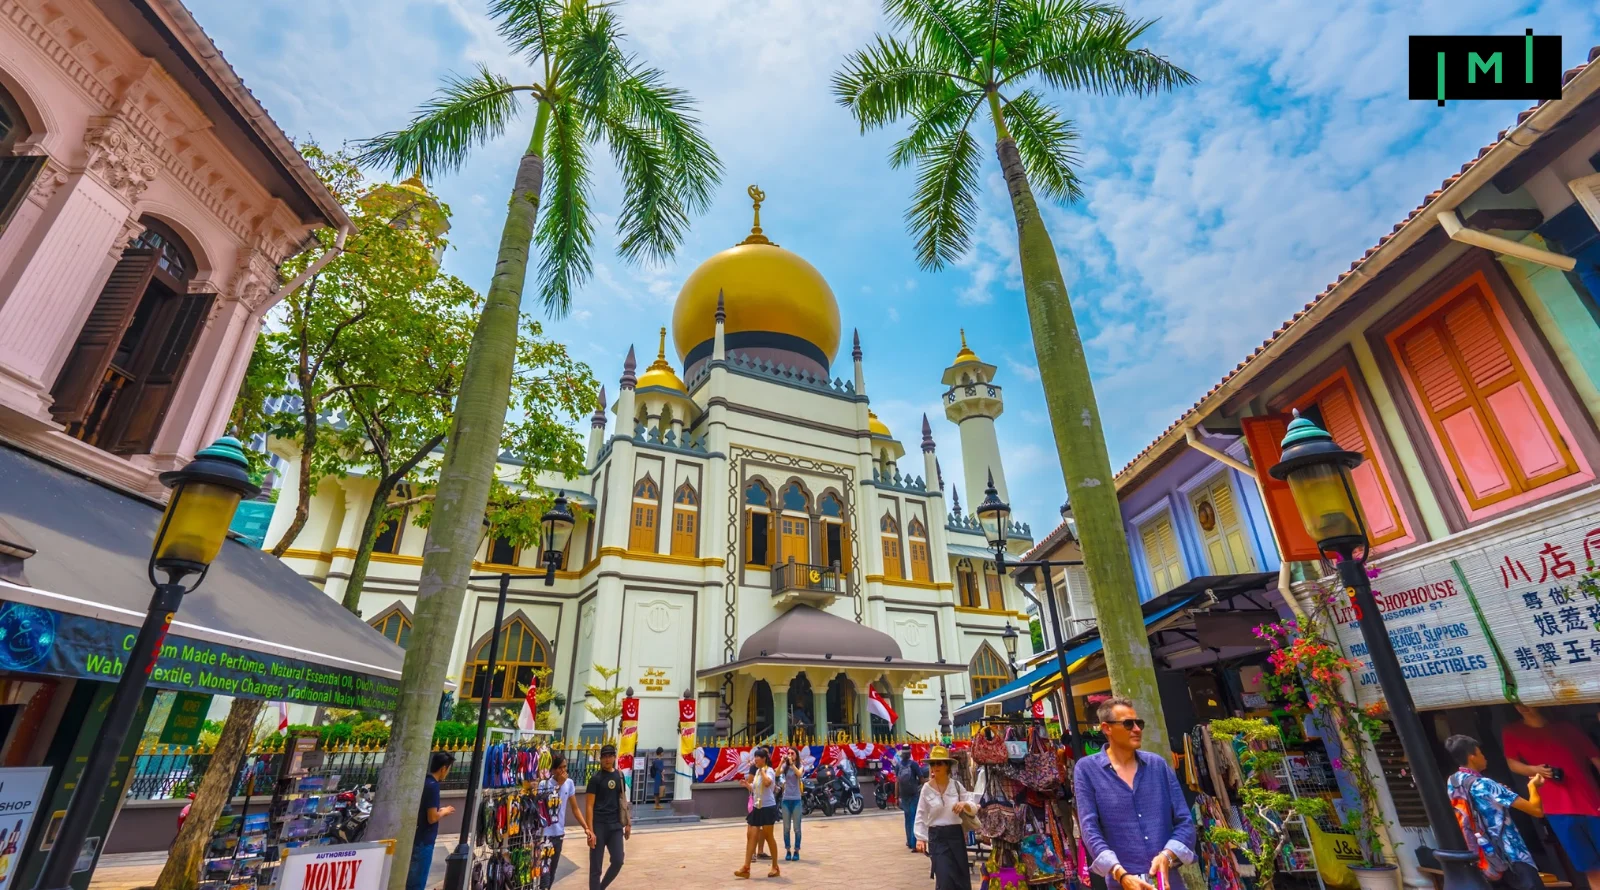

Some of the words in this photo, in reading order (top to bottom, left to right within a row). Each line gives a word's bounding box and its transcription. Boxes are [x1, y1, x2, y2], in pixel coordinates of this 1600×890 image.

[1375, 579, 1458, 613] SHOPHOUSE
[1382, 604, 1425, 621] USSORAH
[1430, 601, 1448, 611] ST.
[1388, 626, 1413, 636] ALISED
[1390, 631, 1422, 649] BEADED
[1425, 622, 1469, 643] SLIPPERS
[181, 645, 217, 665] Made
[220, 653, 267, 676] Perfume,
[270, 663, 304, 680] Natural
[306, 668, 340, 685] Essential
[1432, 646, 1463, 659] 2328
[1360, 671, 1378, 686] JAD
[1401, 654, 1488, 680] COLLECTIBLES
[198, 671, 238, 693] Money
[240, 677, 284, 699] Changer,
[287, 684, 332, 702] Traditional
[0, 800, 31, 811] SHOP
[316, 850, 357, 860] AUTHORISED
[302, 860, 362, 890] MONEY
